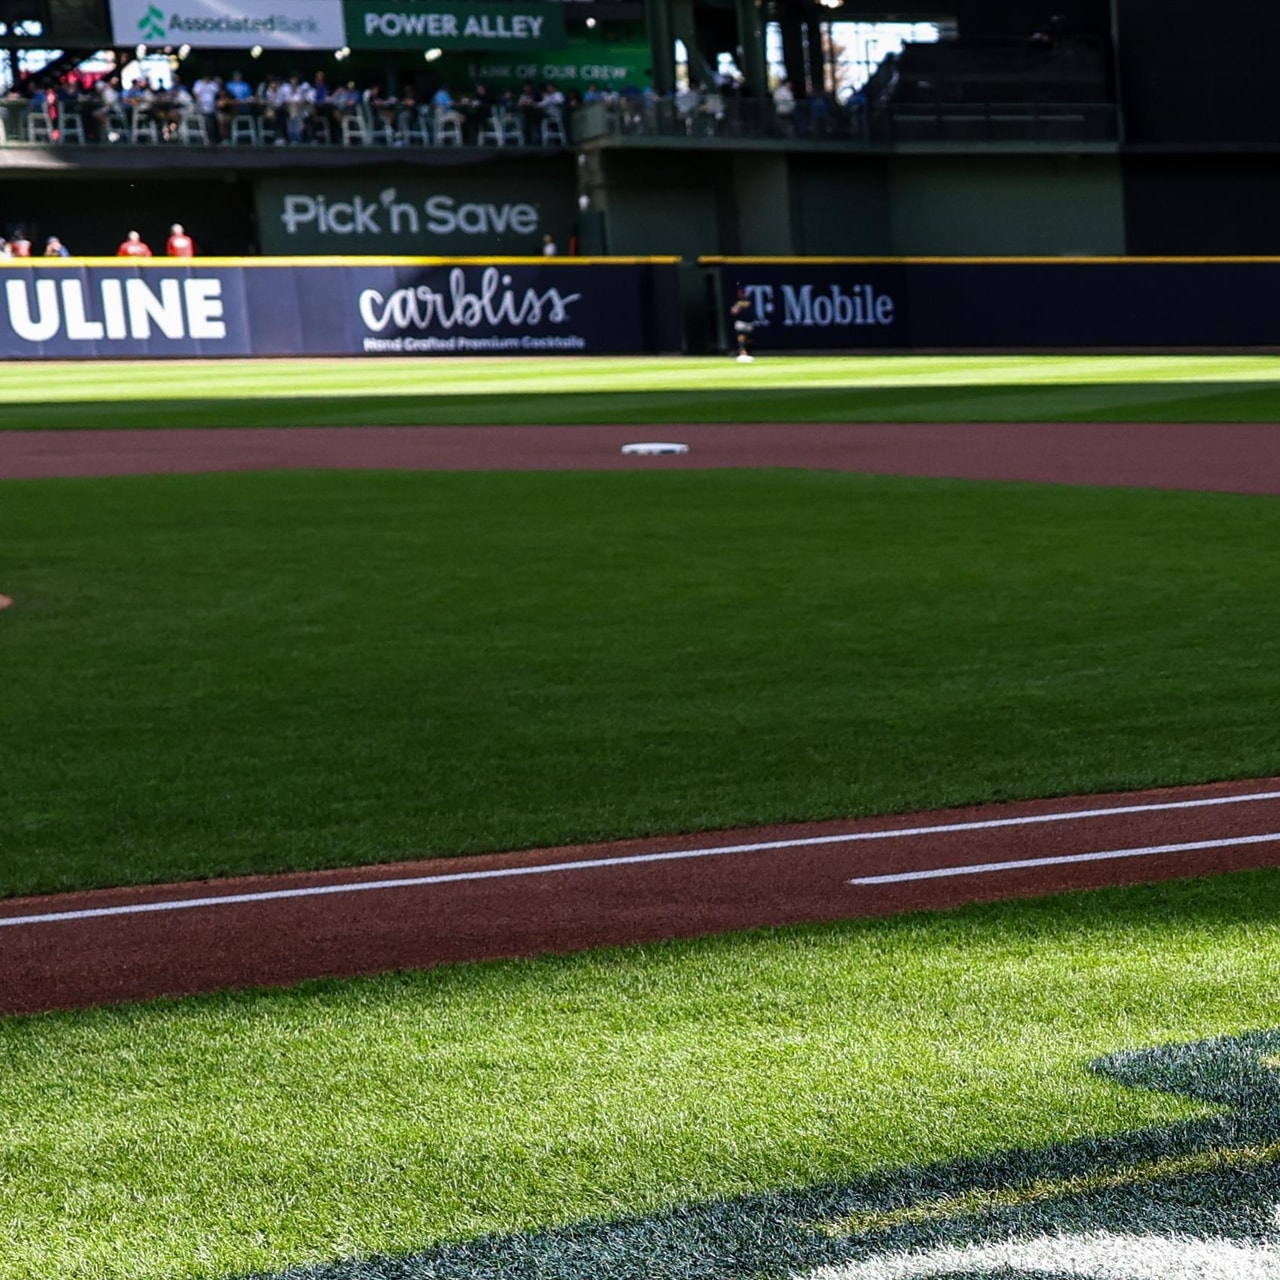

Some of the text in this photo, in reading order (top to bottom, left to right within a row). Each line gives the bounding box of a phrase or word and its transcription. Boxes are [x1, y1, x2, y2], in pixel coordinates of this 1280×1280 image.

[364, 12, 545, 38] POWER ALLEY
[514, 64, 538, 79] OF
[541, 64, 578, 80] OUR
[580, 64, 628, 80] CREW
[425, 196, 539, 234] Save
[5, 278, 227, 341] ULINE
[359, 266, 582, 332] carbliss
